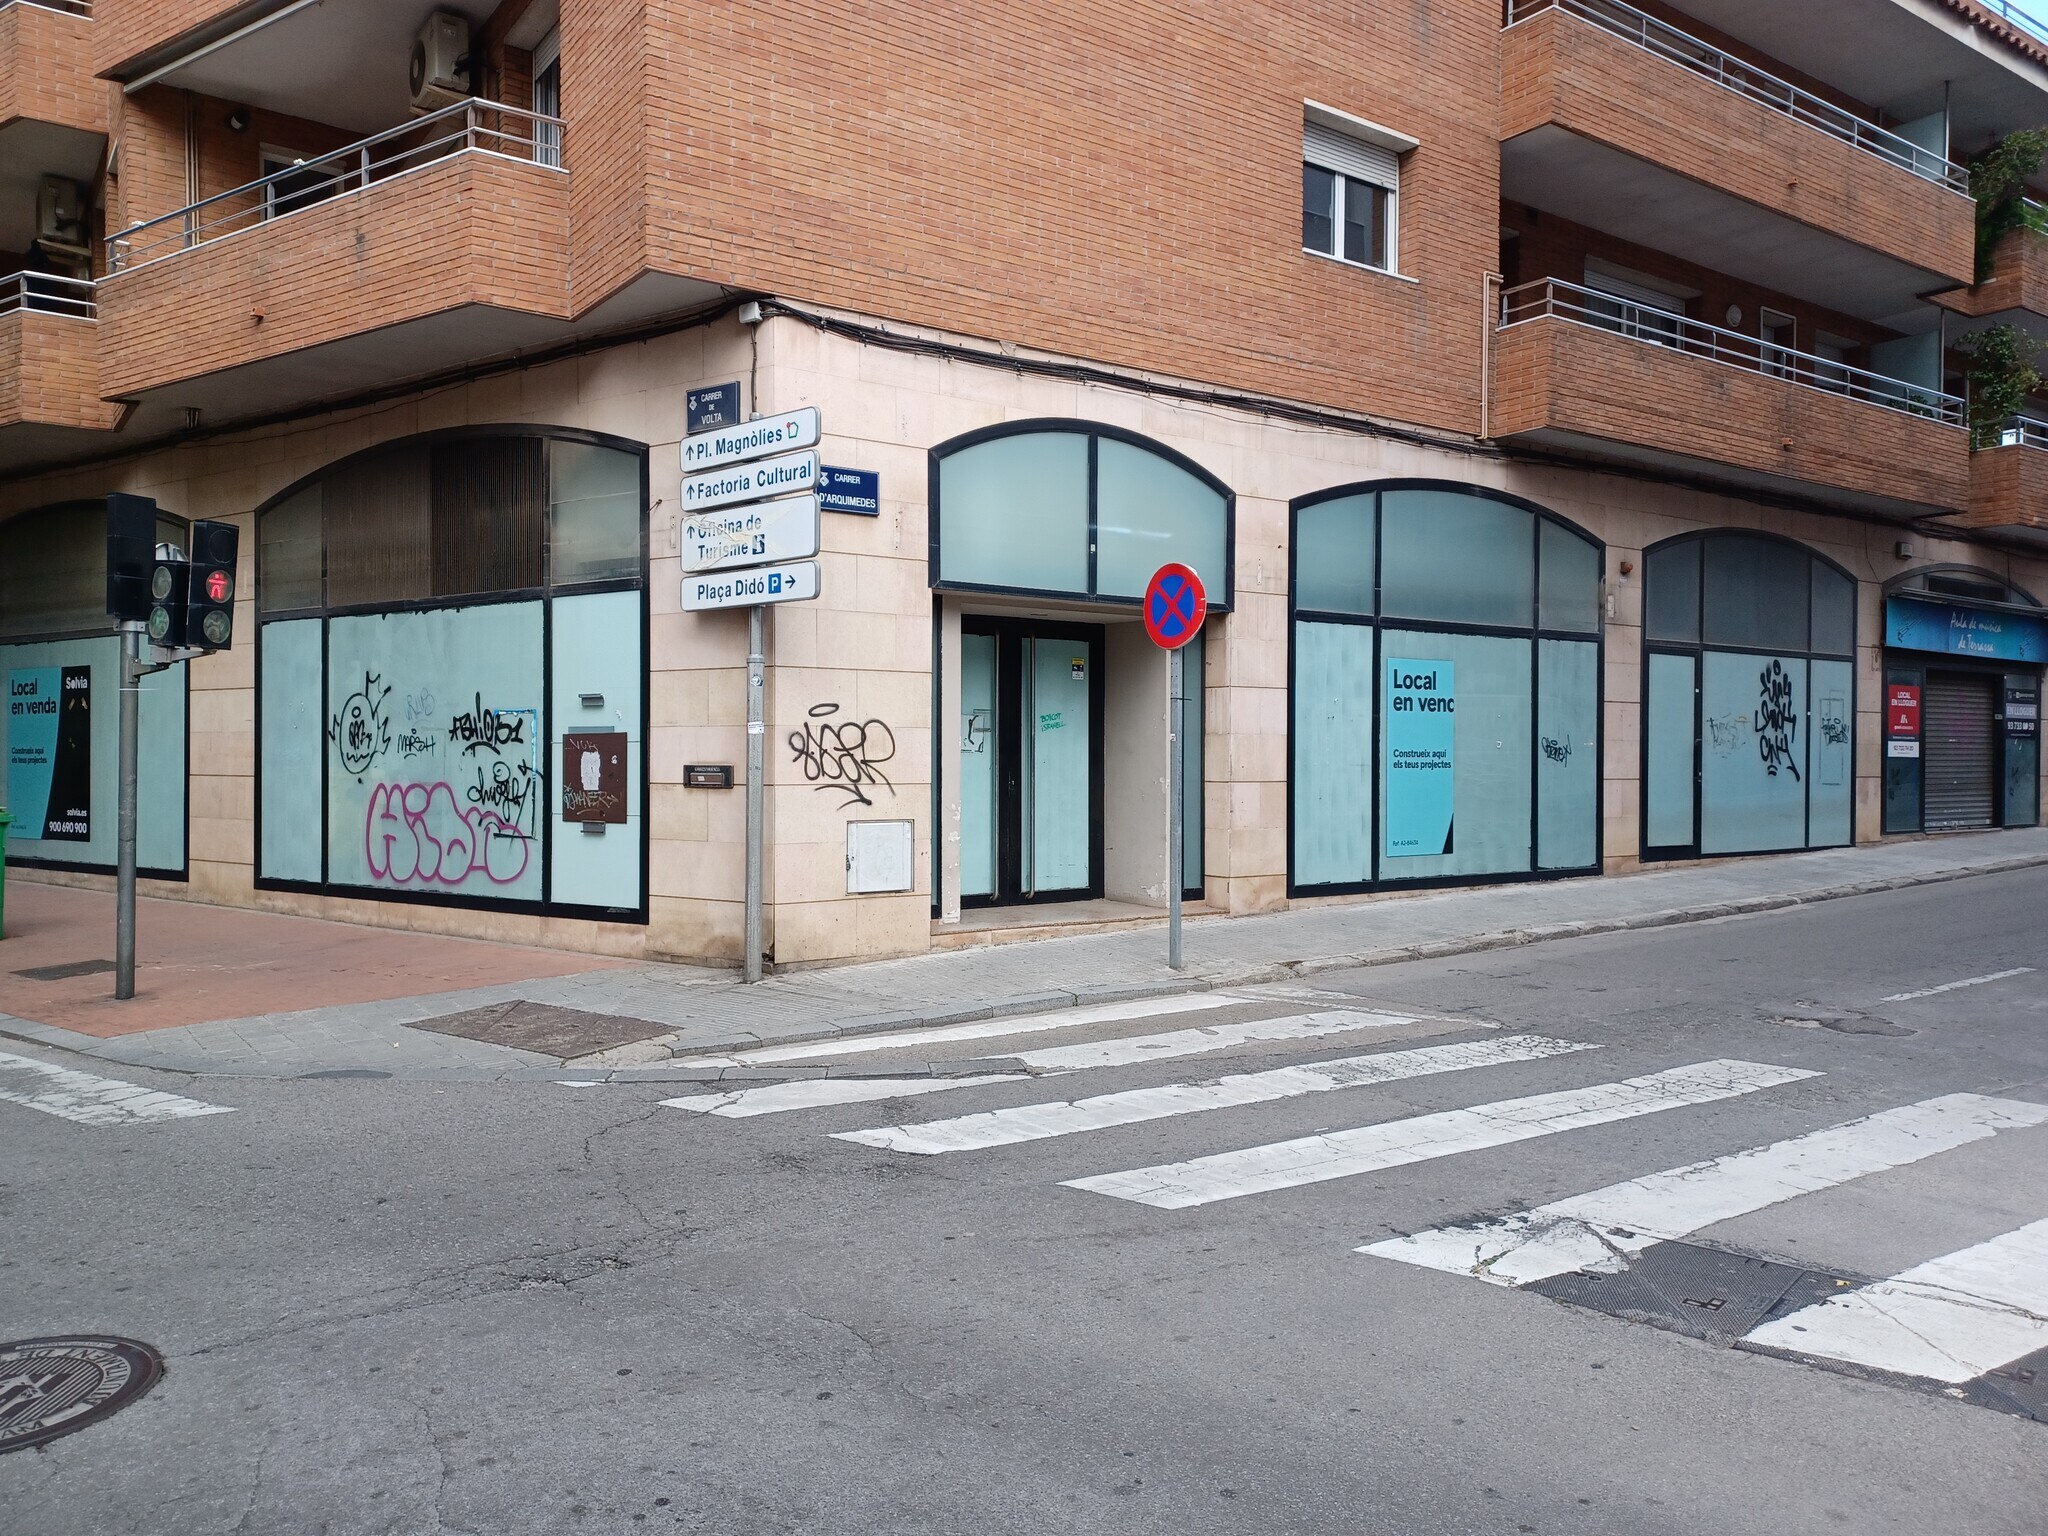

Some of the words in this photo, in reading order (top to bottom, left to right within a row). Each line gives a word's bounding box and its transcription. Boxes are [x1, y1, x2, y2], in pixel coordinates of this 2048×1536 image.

[701, 391, 722, 402] CARRER
[701, 413, 723, 425] VOLTA
[697, 443, 712, 461] Pl.
[716, 428, 783, 455] Magnòlies
[697, 475, 751, 499] Factoria
[757, 461, 812, 487] Cultural
[834, 473, 861, 485] CARRER
[819, 493, 876, 509] D'ARQUIMEDES
[746, 514, 762, 531] de
[697, 584, 732, 603] Plaça
[735, 578, 765, 597] Didó
[1951, 611, 1967, 629] Aula
[1969, 616, 1977, 630] de
[1958, 634, 1966, 649] de
[11, 678, 38, 696] Local
[65, 676, 88, 690] Solvia
[1393, 669, 1437, 690] Local
[1897, 691, 1911, 699] LOCAL
[11, 701, 24, 715] en
[26, 697, 57, 714] venda
[1393, 696, 1413, 712] en
[1393, 749, 1431, 759] Construeix
[1432, 748, 1447, 761] aquí
[1393, 760, 1403, 769] els
[1404, 761, 1419, 769] teus
[1420, 760, 1452, 770] projectes
[49, 821, 61, 832] 900
[62, 822, 74, 833] 690
[75, 822, 87, 834] 900
